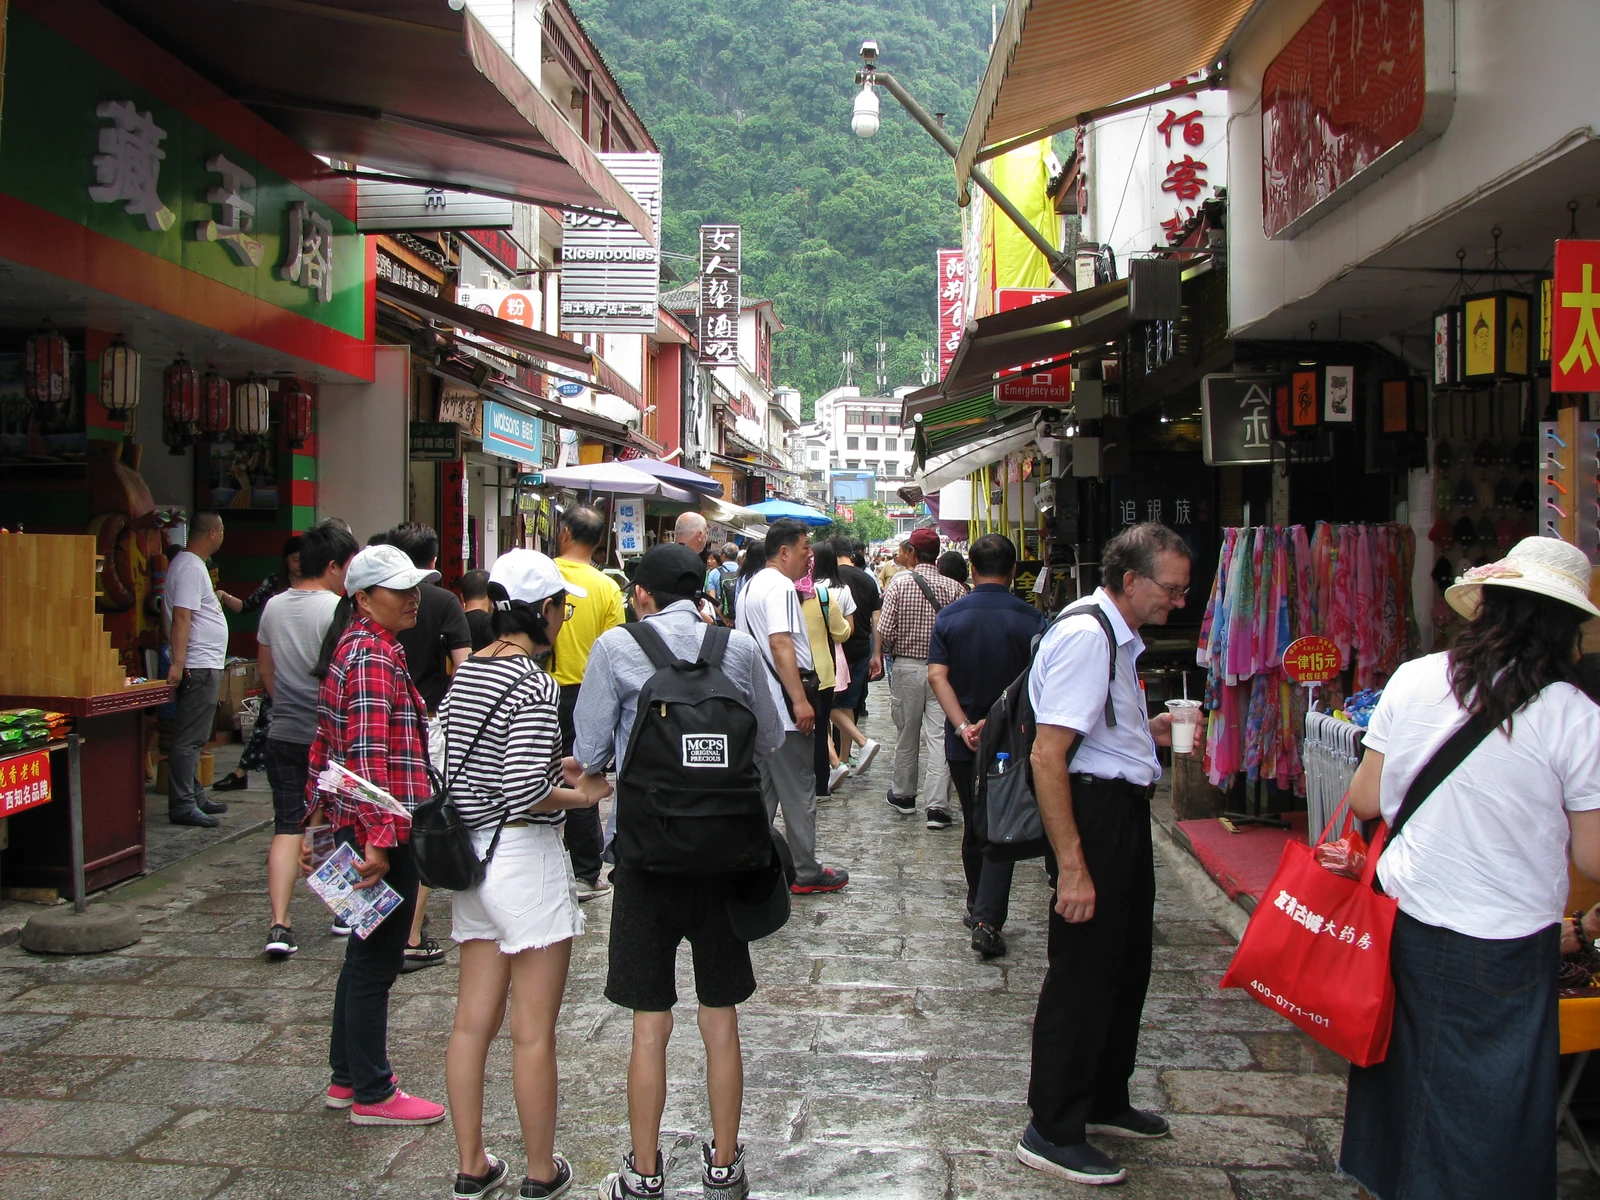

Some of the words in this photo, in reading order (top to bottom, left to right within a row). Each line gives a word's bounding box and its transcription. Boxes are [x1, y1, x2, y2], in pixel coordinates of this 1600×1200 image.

[88, 100, 333, 303] 藏玉阁
[562, 246, 655, 261] Ricenoodles
[705, 228, 736, 361] 女人帮酒吧
[562, 302, 654, 316] 由土特产店上二楼
[942, 257, 965, 364] 阳朔食品
[1559, 263, 1600, 375] 太
[1004, 384, 1048, 397] Emergency
[1050, 385, 1065, 396] exit
[1119, 498, 1192, 525] 追银族
[1286, 652, 1336, 671] 一律15元
[687, 739, 723, 751] MCPS
[1250, 979, 1330, 1028] 400-0771-101
